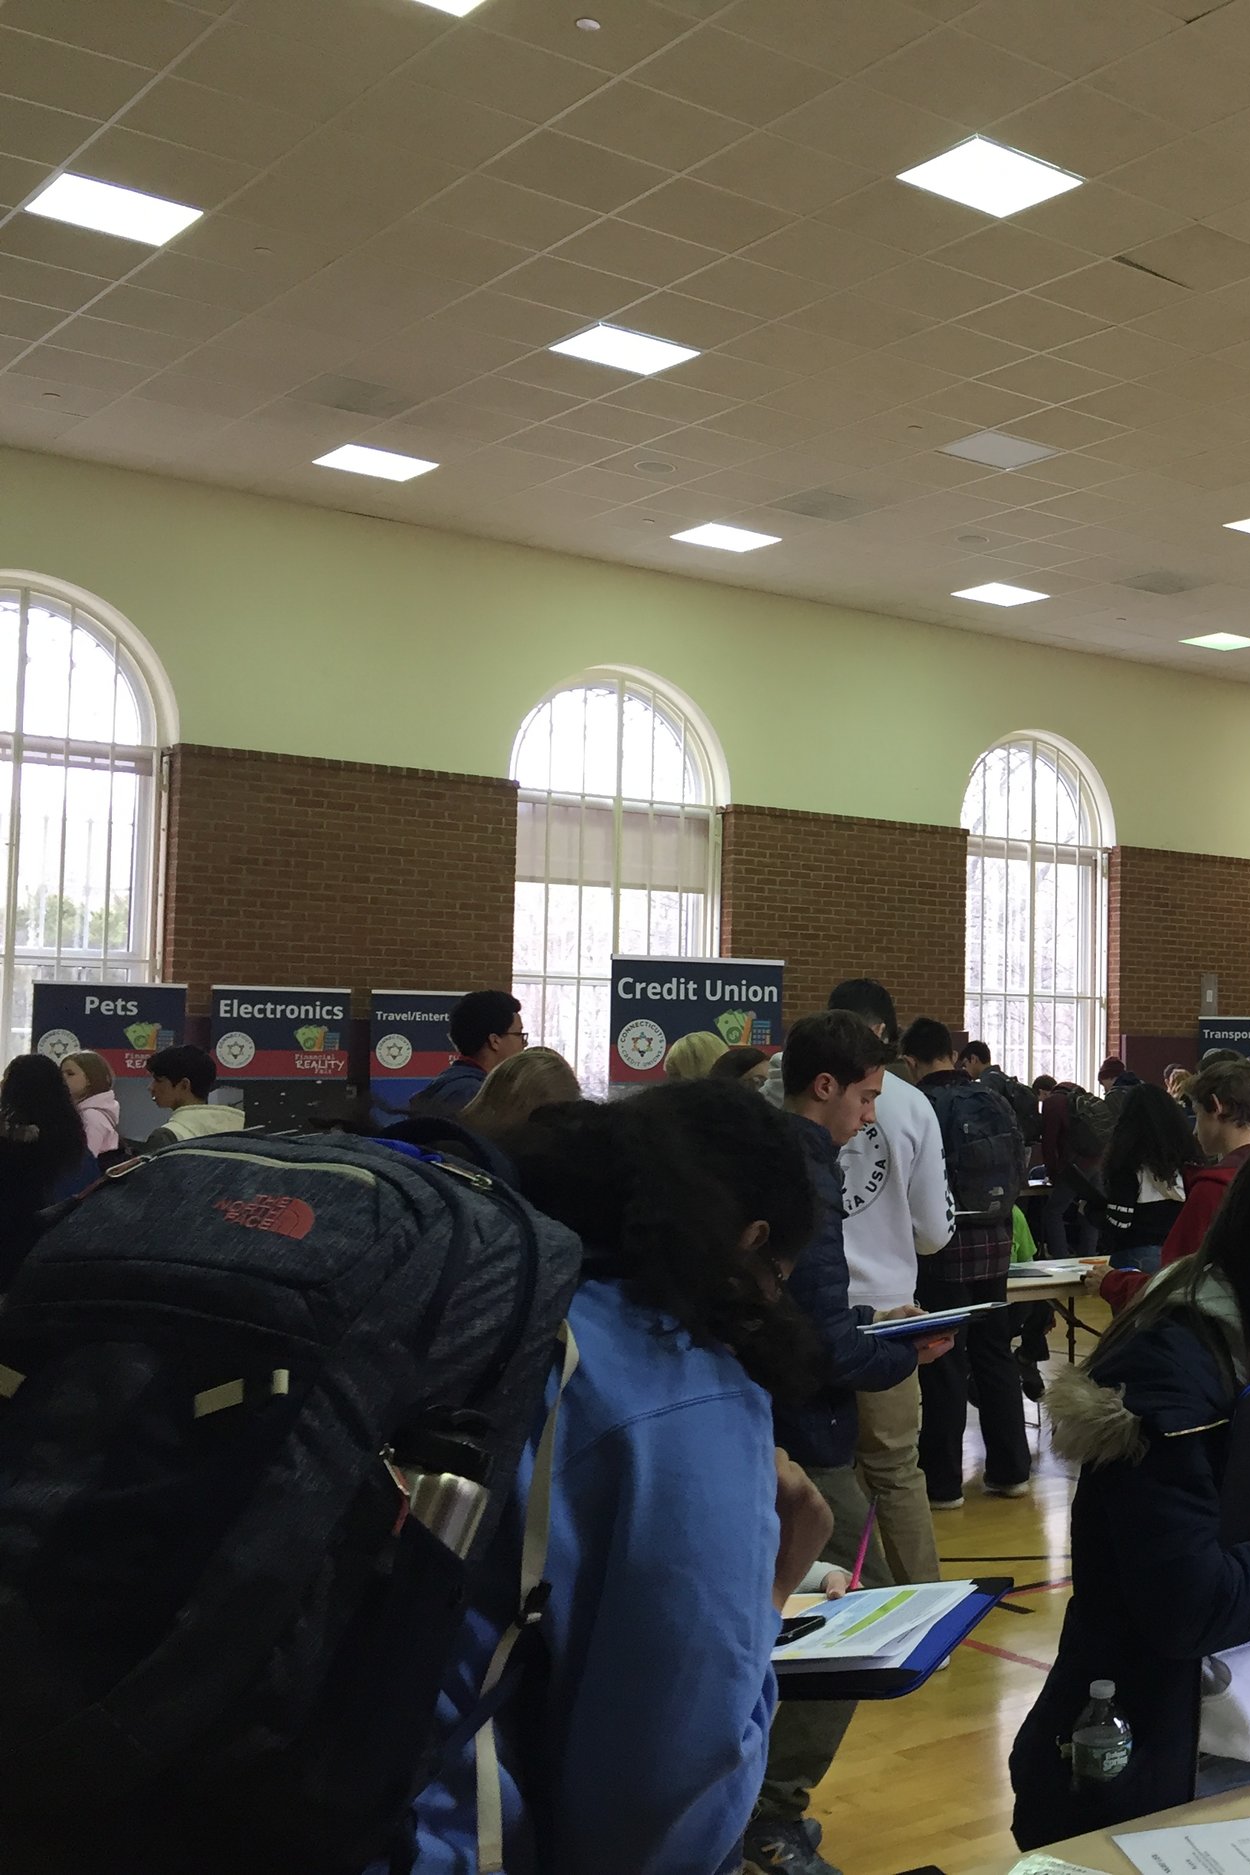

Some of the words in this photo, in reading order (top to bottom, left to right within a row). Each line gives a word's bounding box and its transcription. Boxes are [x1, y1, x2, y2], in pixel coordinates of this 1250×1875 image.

[617, 977, 698, 1001] Credit
[705, 979, 778, 1003] Union
[84, 996, 139, 1016] Pets
[219, 999, 344, 1020] Electronics
[295, 1060, 345, 1072] REALITY
[865, 1159, 887, 1193] USA
[212, 1200, 280, 1218] NORTH
[256, 1194, 293, 1209] THE
[223, 1212, 275, 1230] FACE
